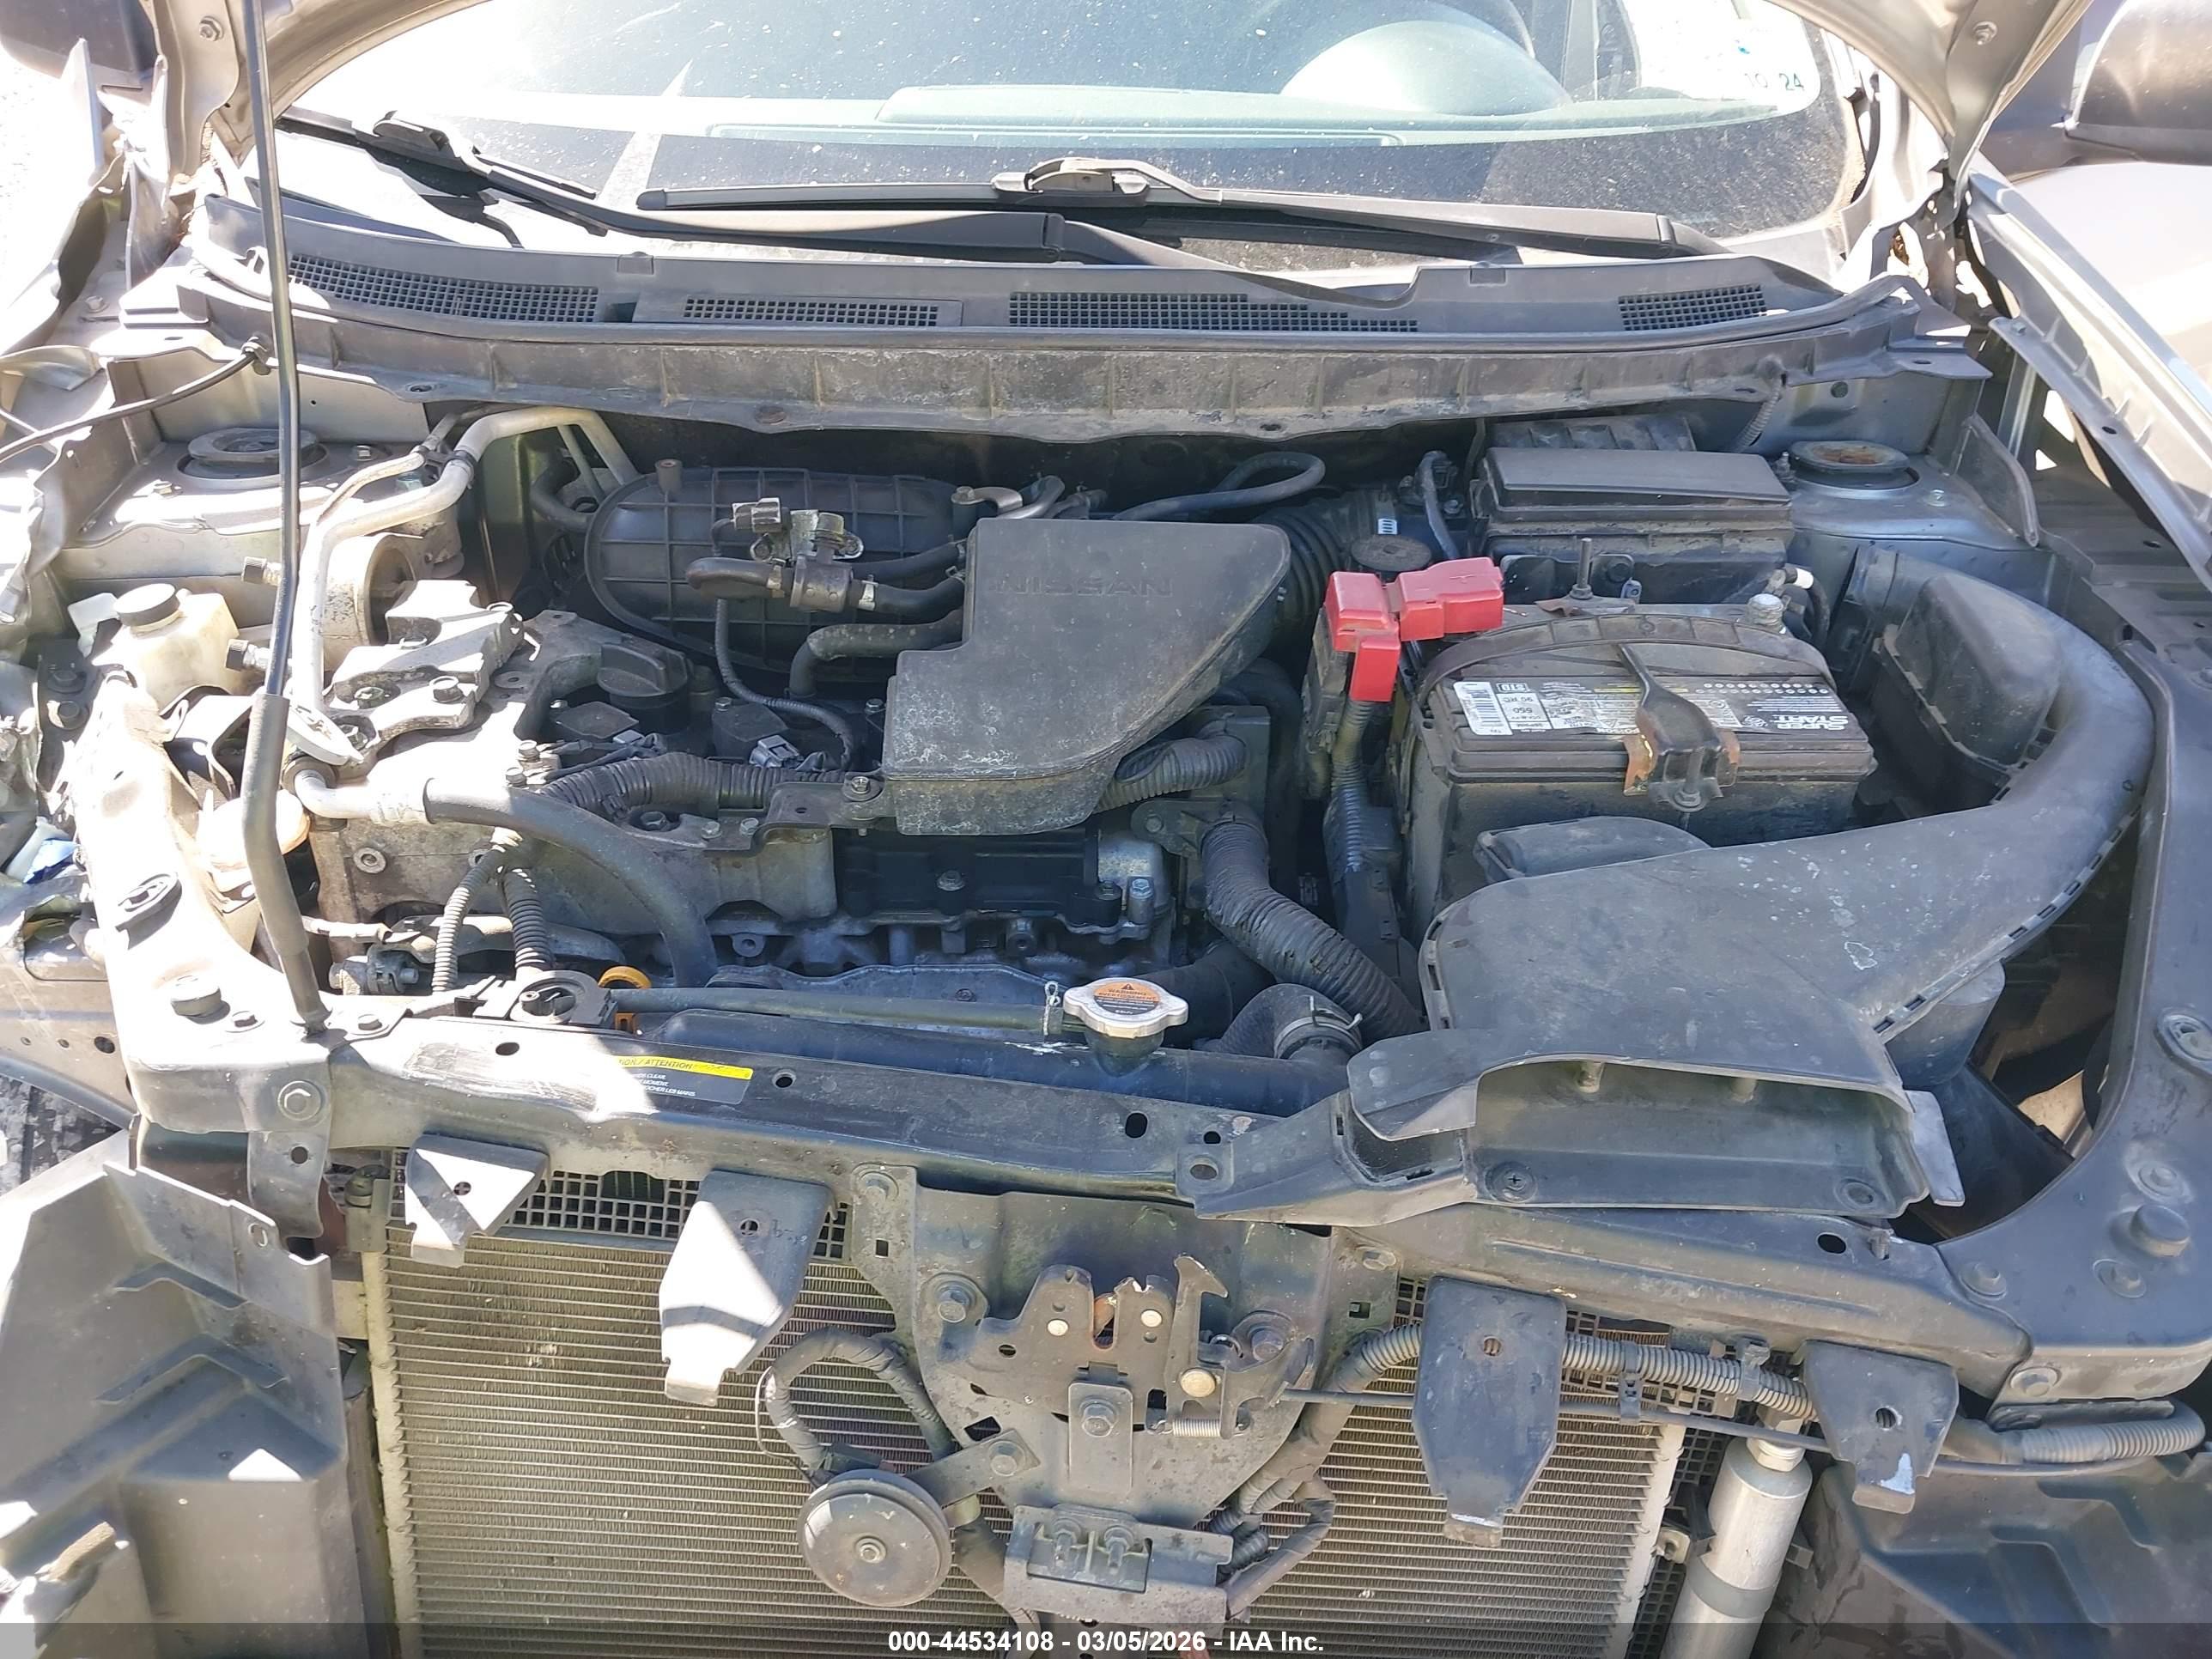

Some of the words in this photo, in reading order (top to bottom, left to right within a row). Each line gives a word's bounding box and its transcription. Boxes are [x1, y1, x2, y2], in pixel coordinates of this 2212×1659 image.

[1778, 72, 1805, 91] 24
[991, 576, 1174, 599] NISSAN
[1778, 722, 1844, 731] SUPER
[645, 1059, 694, 1070] ATTENTION
